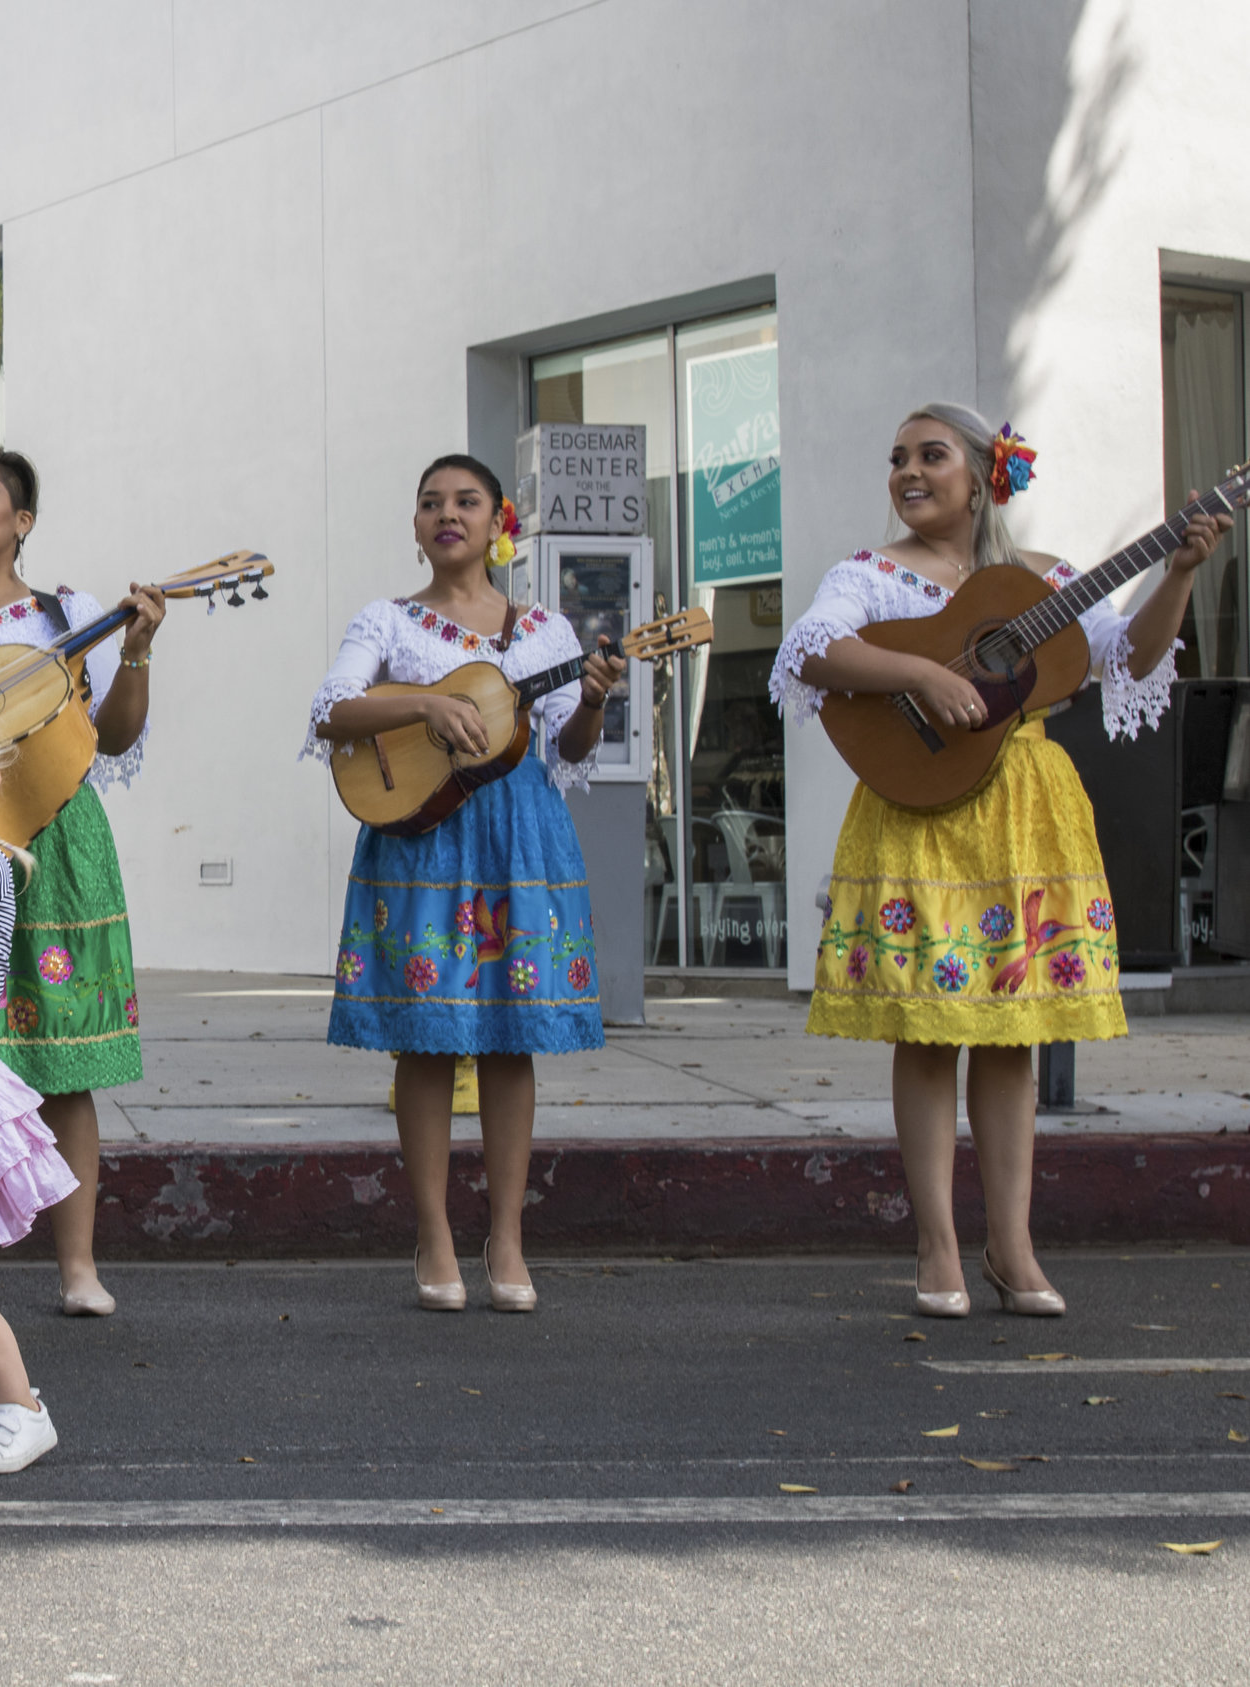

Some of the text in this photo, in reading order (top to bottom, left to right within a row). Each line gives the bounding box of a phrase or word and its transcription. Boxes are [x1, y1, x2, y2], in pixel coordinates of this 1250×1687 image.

[550, 432, 637, 451] EDGEMAR
[549, 456, 638, 477] CENTER
[577, 481, 610, 492] FOR THE
[549, 494, 639, 523] ARTS
[719, 504, 739, 522] New
[699, 527, 780, 552] men's & women's
[702, 545, 779, 572] buy. sell. trade.
[700, 915, 751, 945] buying
